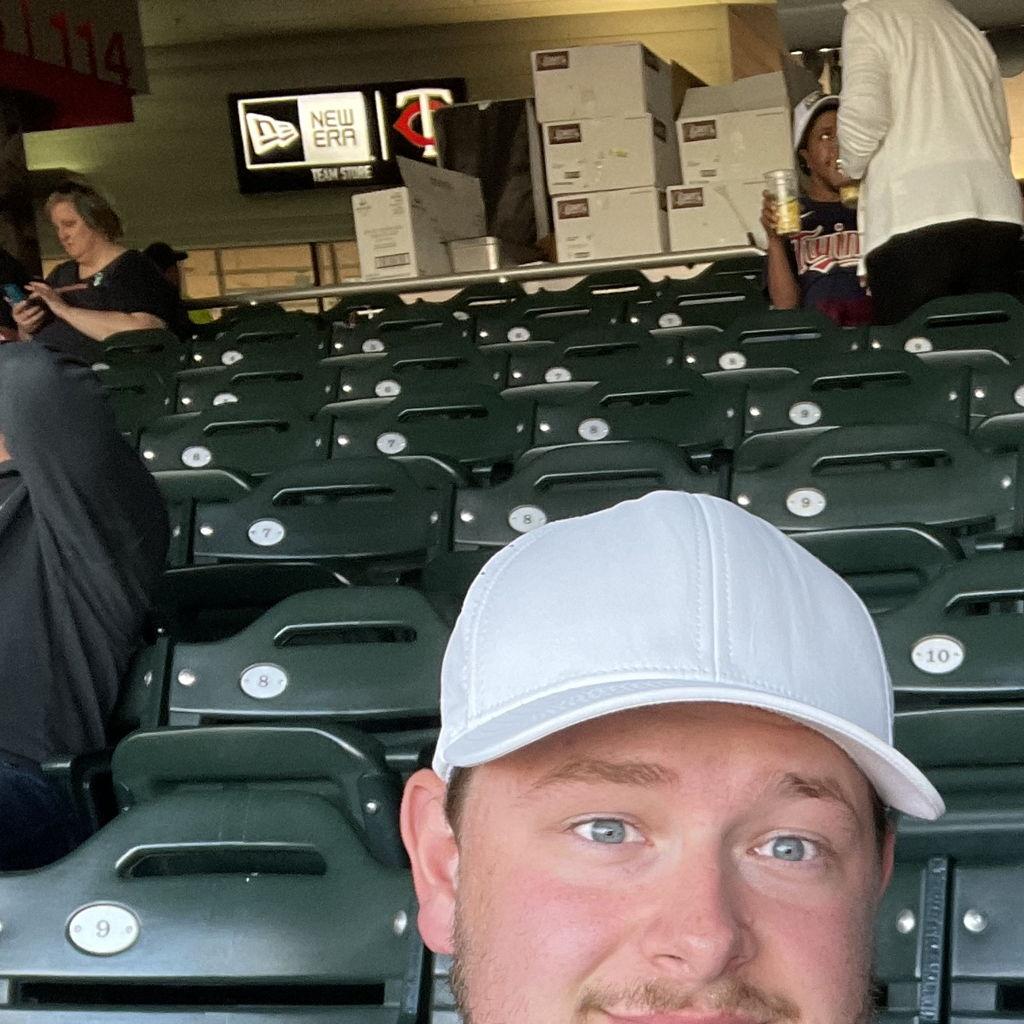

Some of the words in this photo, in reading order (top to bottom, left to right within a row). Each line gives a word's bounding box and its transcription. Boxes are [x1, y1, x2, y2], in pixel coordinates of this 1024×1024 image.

[310, 109, 354, 129] NEW
[312, 128, 357, 148] ERA
[789, 224, 863, 275] Twin
[926, 649, 950, 664] 10
[95, 919, 111, 939] 9
